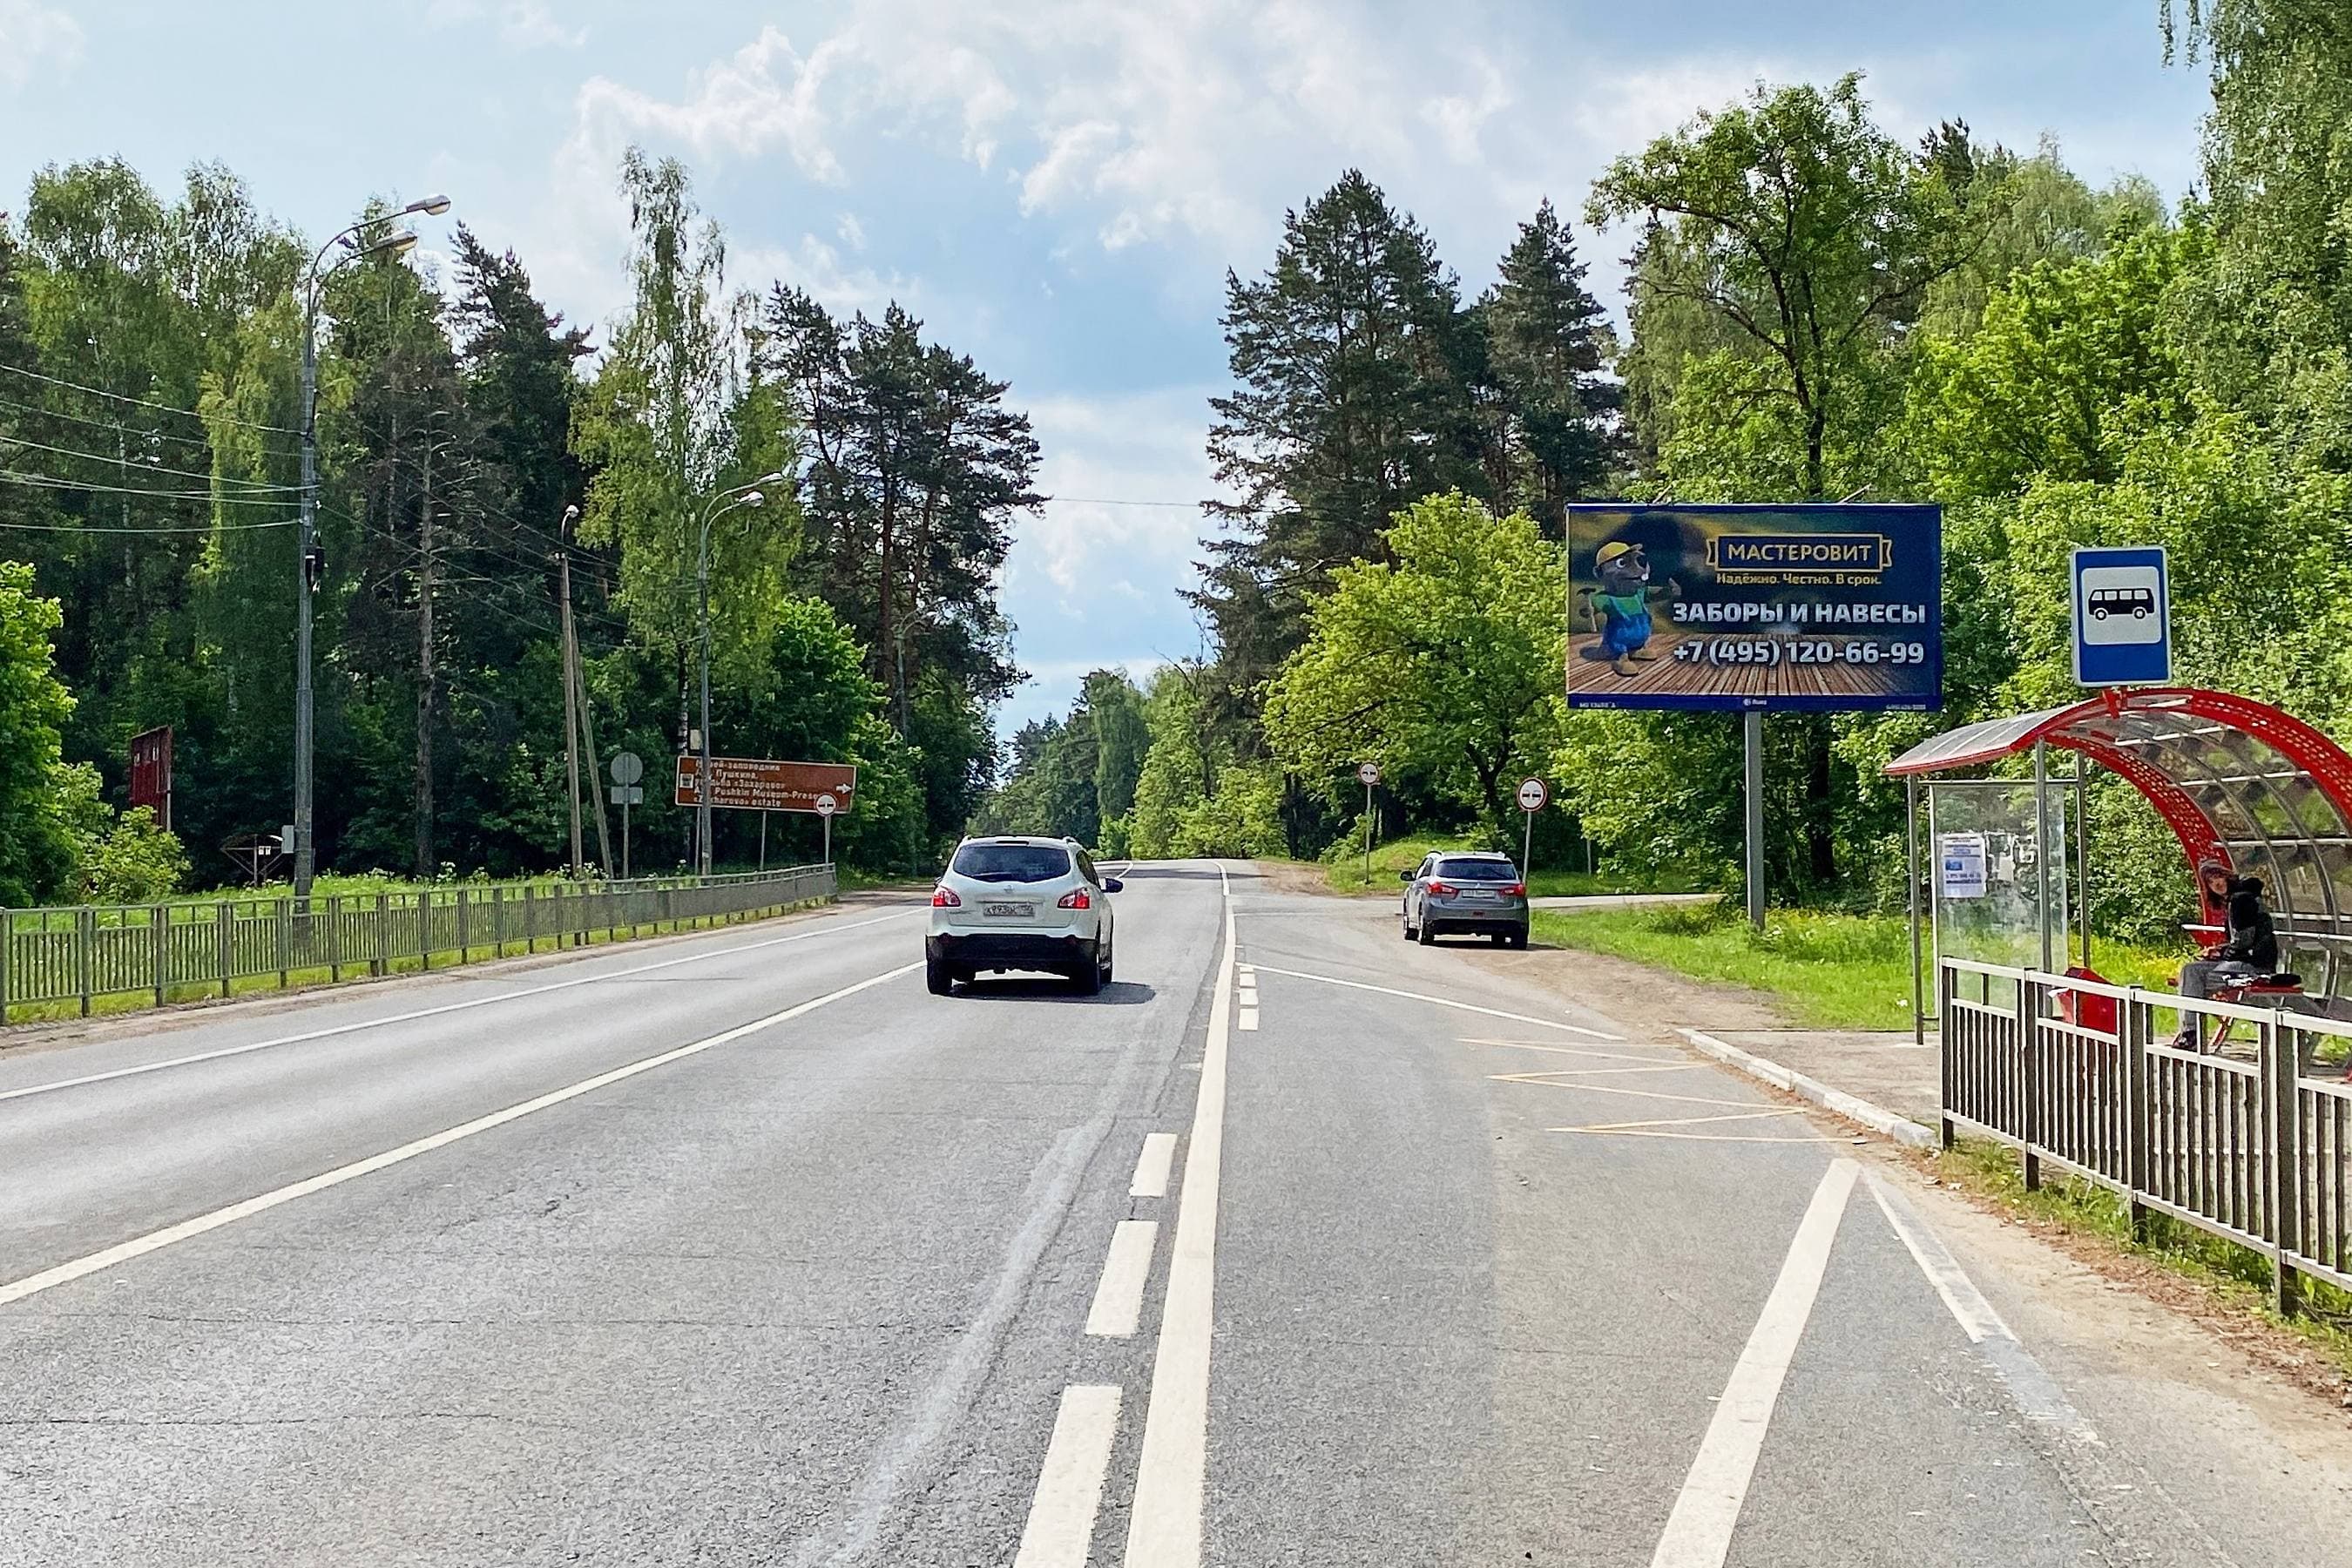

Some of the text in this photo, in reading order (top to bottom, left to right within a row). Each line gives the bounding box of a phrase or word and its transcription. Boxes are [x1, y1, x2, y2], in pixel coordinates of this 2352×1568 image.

[1727, 544, 1872, 561] МАСТЕРОВИТ
[1716, 572, 1882, 587] Надёжно. Честно. В срок.
[1673, 602, 1926, 624] ЗАБОРЫ И НАВЕСЫ
[1673, 639, 1924, 666] +7 (495) 120-66-99
[753, 788, 820, 801] Museum-Prese
